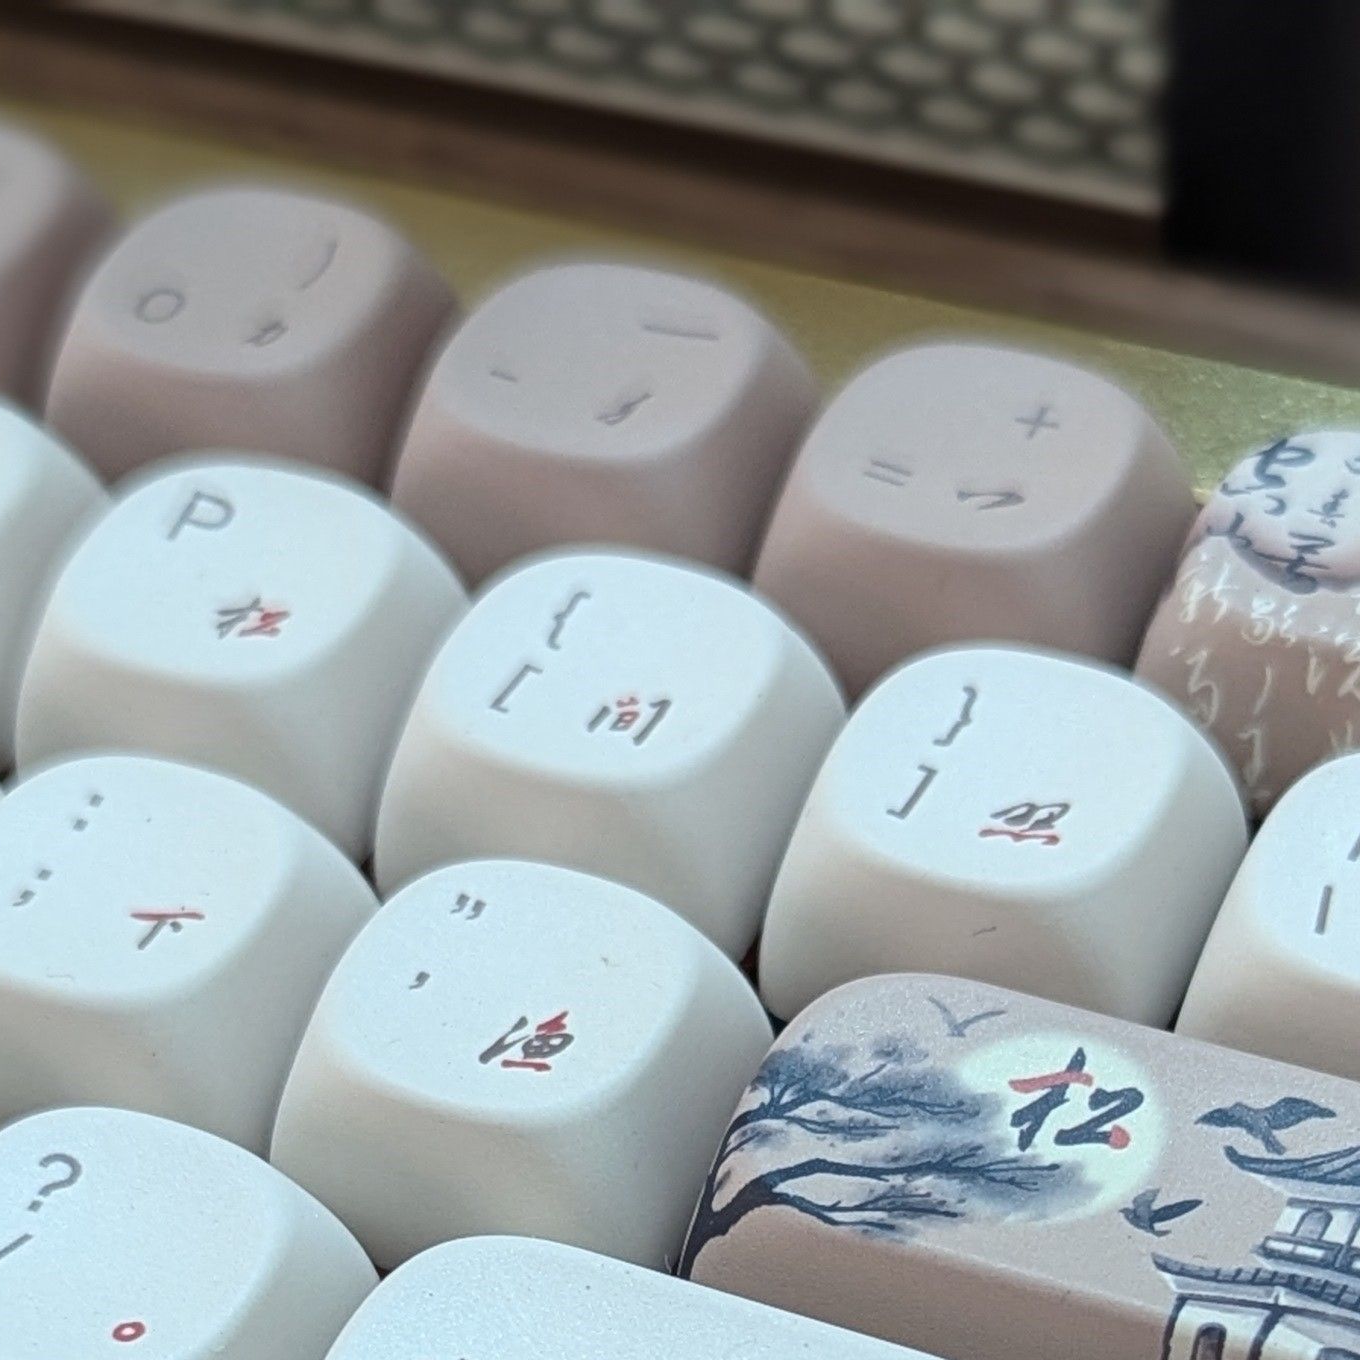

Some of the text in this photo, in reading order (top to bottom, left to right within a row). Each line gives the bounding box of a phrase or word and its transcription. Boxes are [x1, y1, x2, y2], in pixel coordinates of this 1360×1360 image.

[166, 489, 236, 541] P
[547, 591, 591, 651] {
[490, 663, 543, 713] [
[932, 685, 978, 746] }
[886, 763, 938, 820] ]
[1006, 1046, 1145, 1152] 松
[26, 1153, 83, 1213] ?
